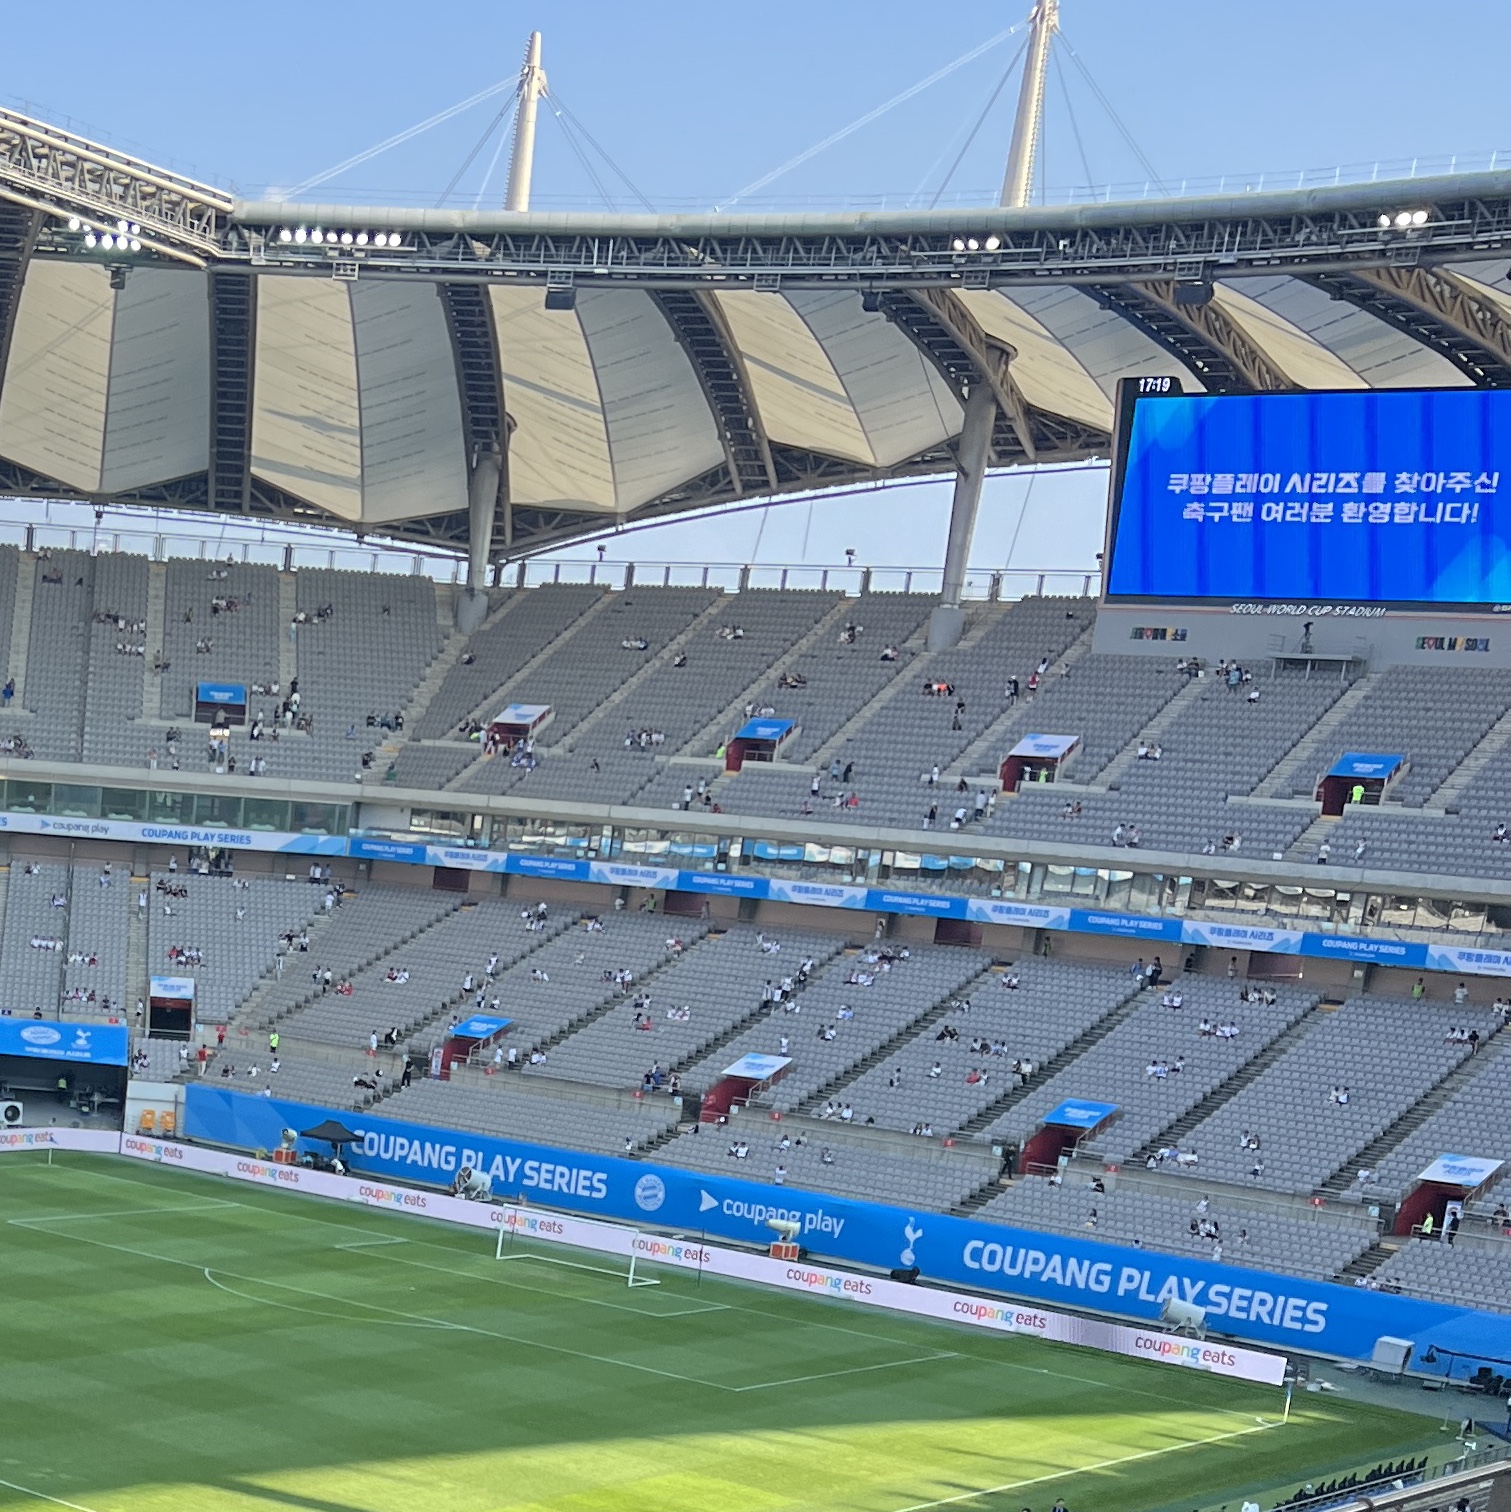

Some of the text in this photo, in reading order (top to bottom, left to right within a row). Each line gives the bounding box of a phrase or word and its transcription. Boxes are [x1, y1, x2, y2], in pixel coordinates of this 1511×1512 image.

[1138, 378, 1171, 392] 17:19
[1167, 470, 1499, 495] 쿠팡플레이 시리즈를 찾아주신
[1182, 501, 1479, 524] 축구팬 여러분 환영합니다!
[1229, 603, 1388, 617] SEOUL WORLD CUP STADIUM
[52, 821, 109, 835] coupang play
[142, 828, 251, 845] COUPANG PLAY SERIES
[1088, 915, 1163, 931] COUPANG PLAY SERIES
[1322, 939, 1406, 956] COUPANG PLAY SERIES
[34, 1131, 55, 1143] eats
[126, 1139, 183, 1162] coupang eats
[237, 1161, 299, 1183] coupang eats
[351, 1130, 456, 1172] COUPANG
[461, 1150, 522, 1184] PLAY
[523, 1161, 608, 1200] SERIES
[359, 1185, 427, 1208] coupang eats
[490, 1210, 564, 1235] coupang eats
[723, 1198, 845, 1239] coupang play
[632, 1237, 710, 1263] coupang eats
[786, 1268, 872, 1295] coupang eats
[963, 1240, 1328, 1334] COUPANG PLAY SERIES
[953, 1301, 1046, 1329] coupang eats
[1135, 1335, 1235, 1367] coupang eats
